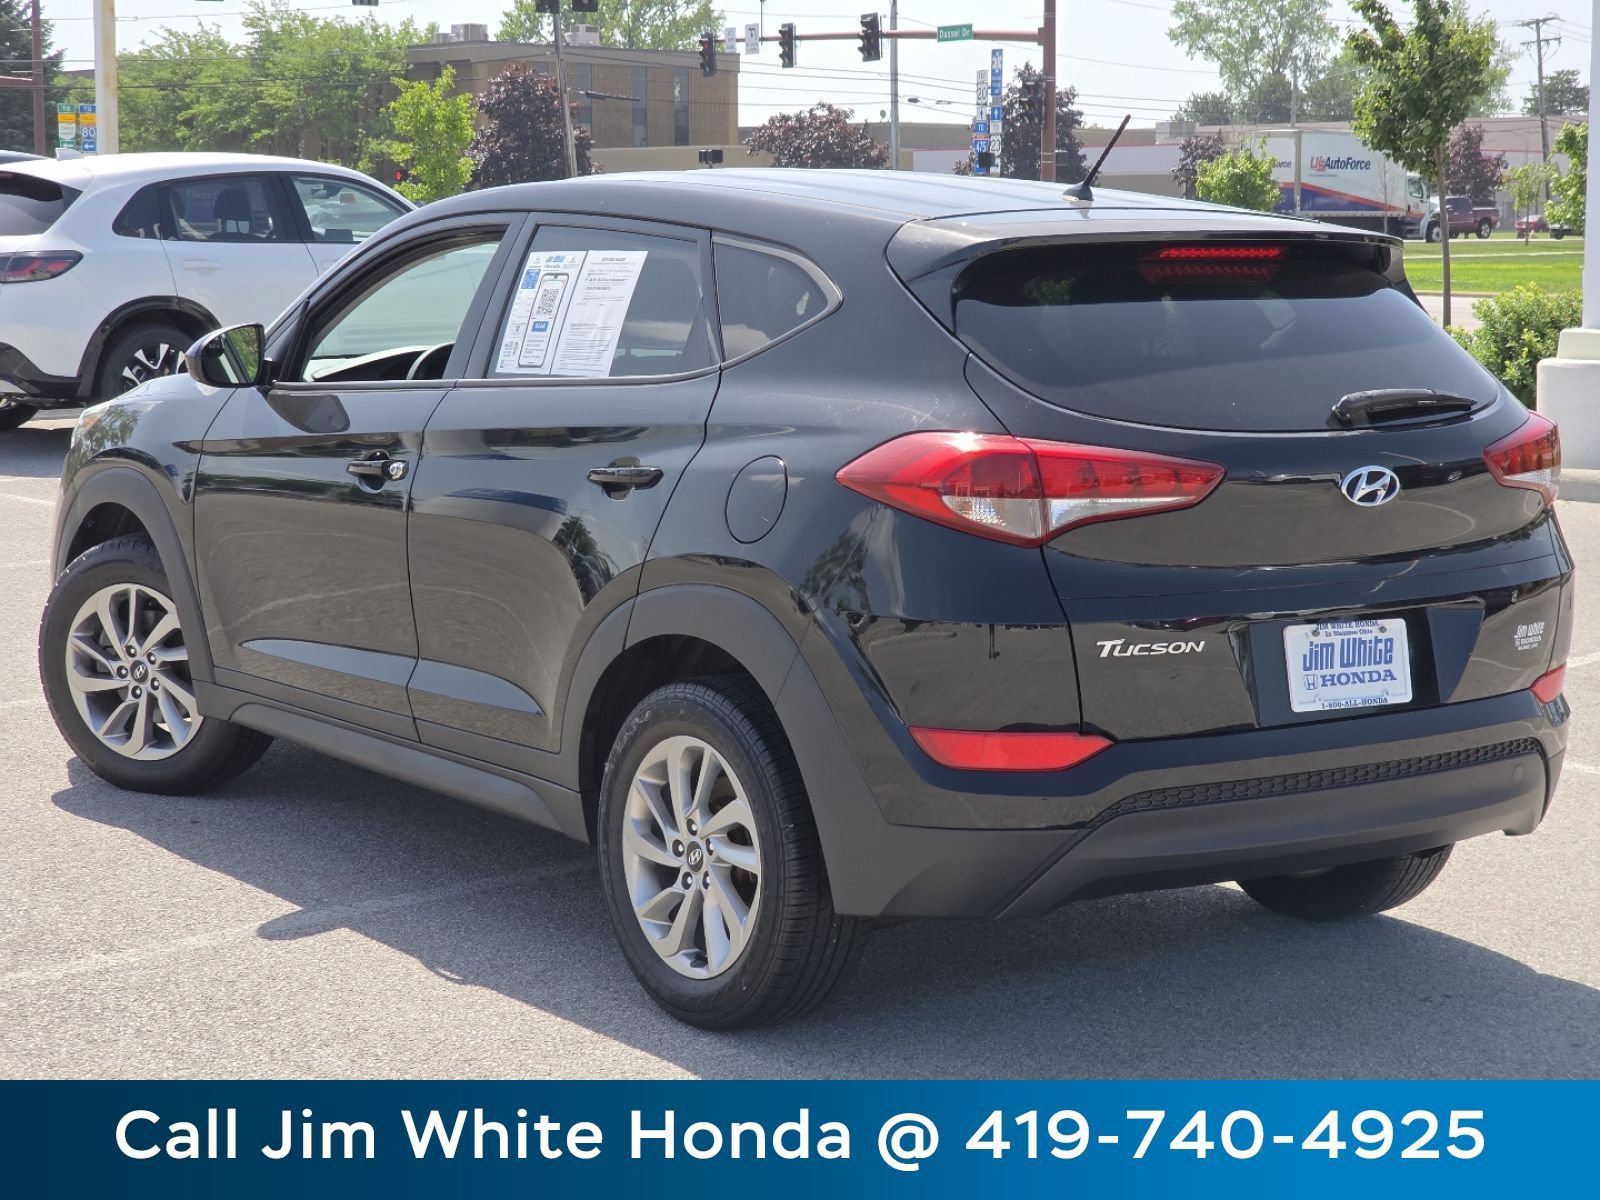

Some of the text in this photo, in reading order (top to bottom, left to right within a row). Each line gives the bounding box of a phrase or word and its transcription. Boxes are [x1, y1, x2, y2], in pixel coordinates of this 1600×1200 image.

[940, 29, 961, 39] Dussel
[977, 87, 987, 100] 20
[82, 127, 96, 138] 80
[1340, 636, 1394, 669] White
[1320, 668, 1397, 688] HONDA
[1321, 697, 1389, 709] 1-800-ALL-HONDA
